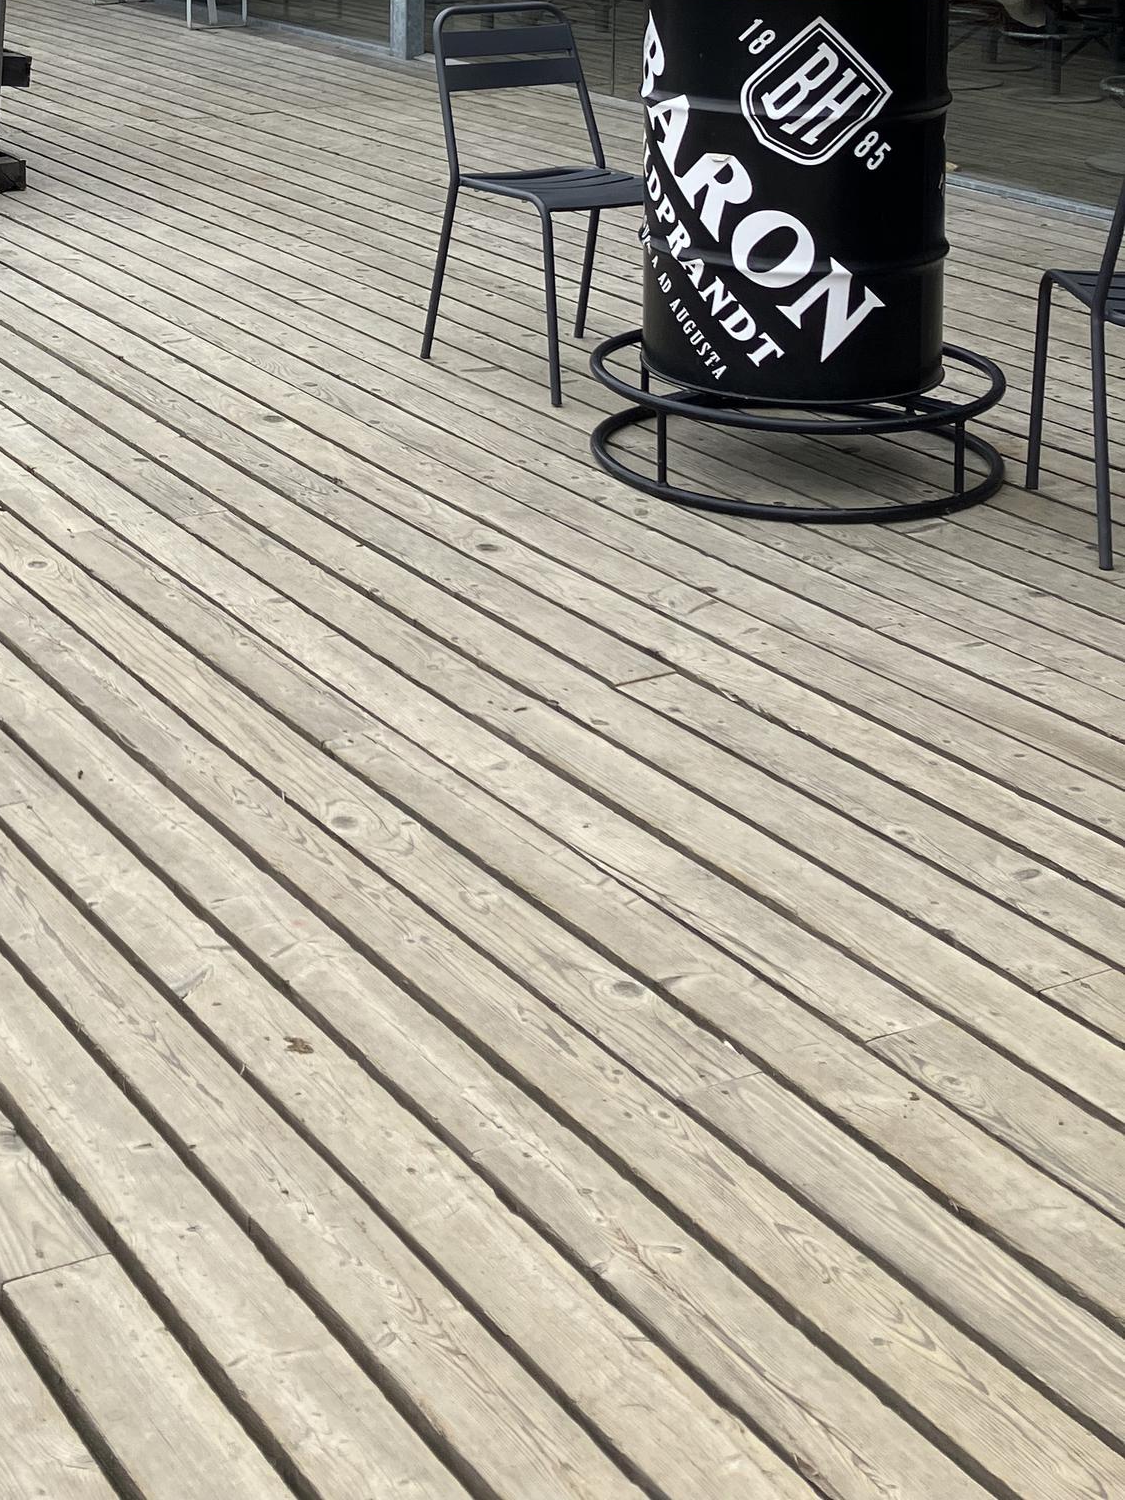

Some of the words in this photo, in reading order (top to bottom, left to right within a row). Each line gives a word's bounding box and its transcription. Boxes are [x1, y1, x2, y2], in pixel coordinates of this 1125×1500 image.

[738, 19, 776, 55] 18
[761, 43, 871, 146] BH
[641, 10, 885, 362] BARON
[854, 132, 891, 170] 85
[643, 128, 784, 367] LDPRANDT
[657, 272, 672, 293] AD
[669, 298, 727, 380] AUGUSTA
